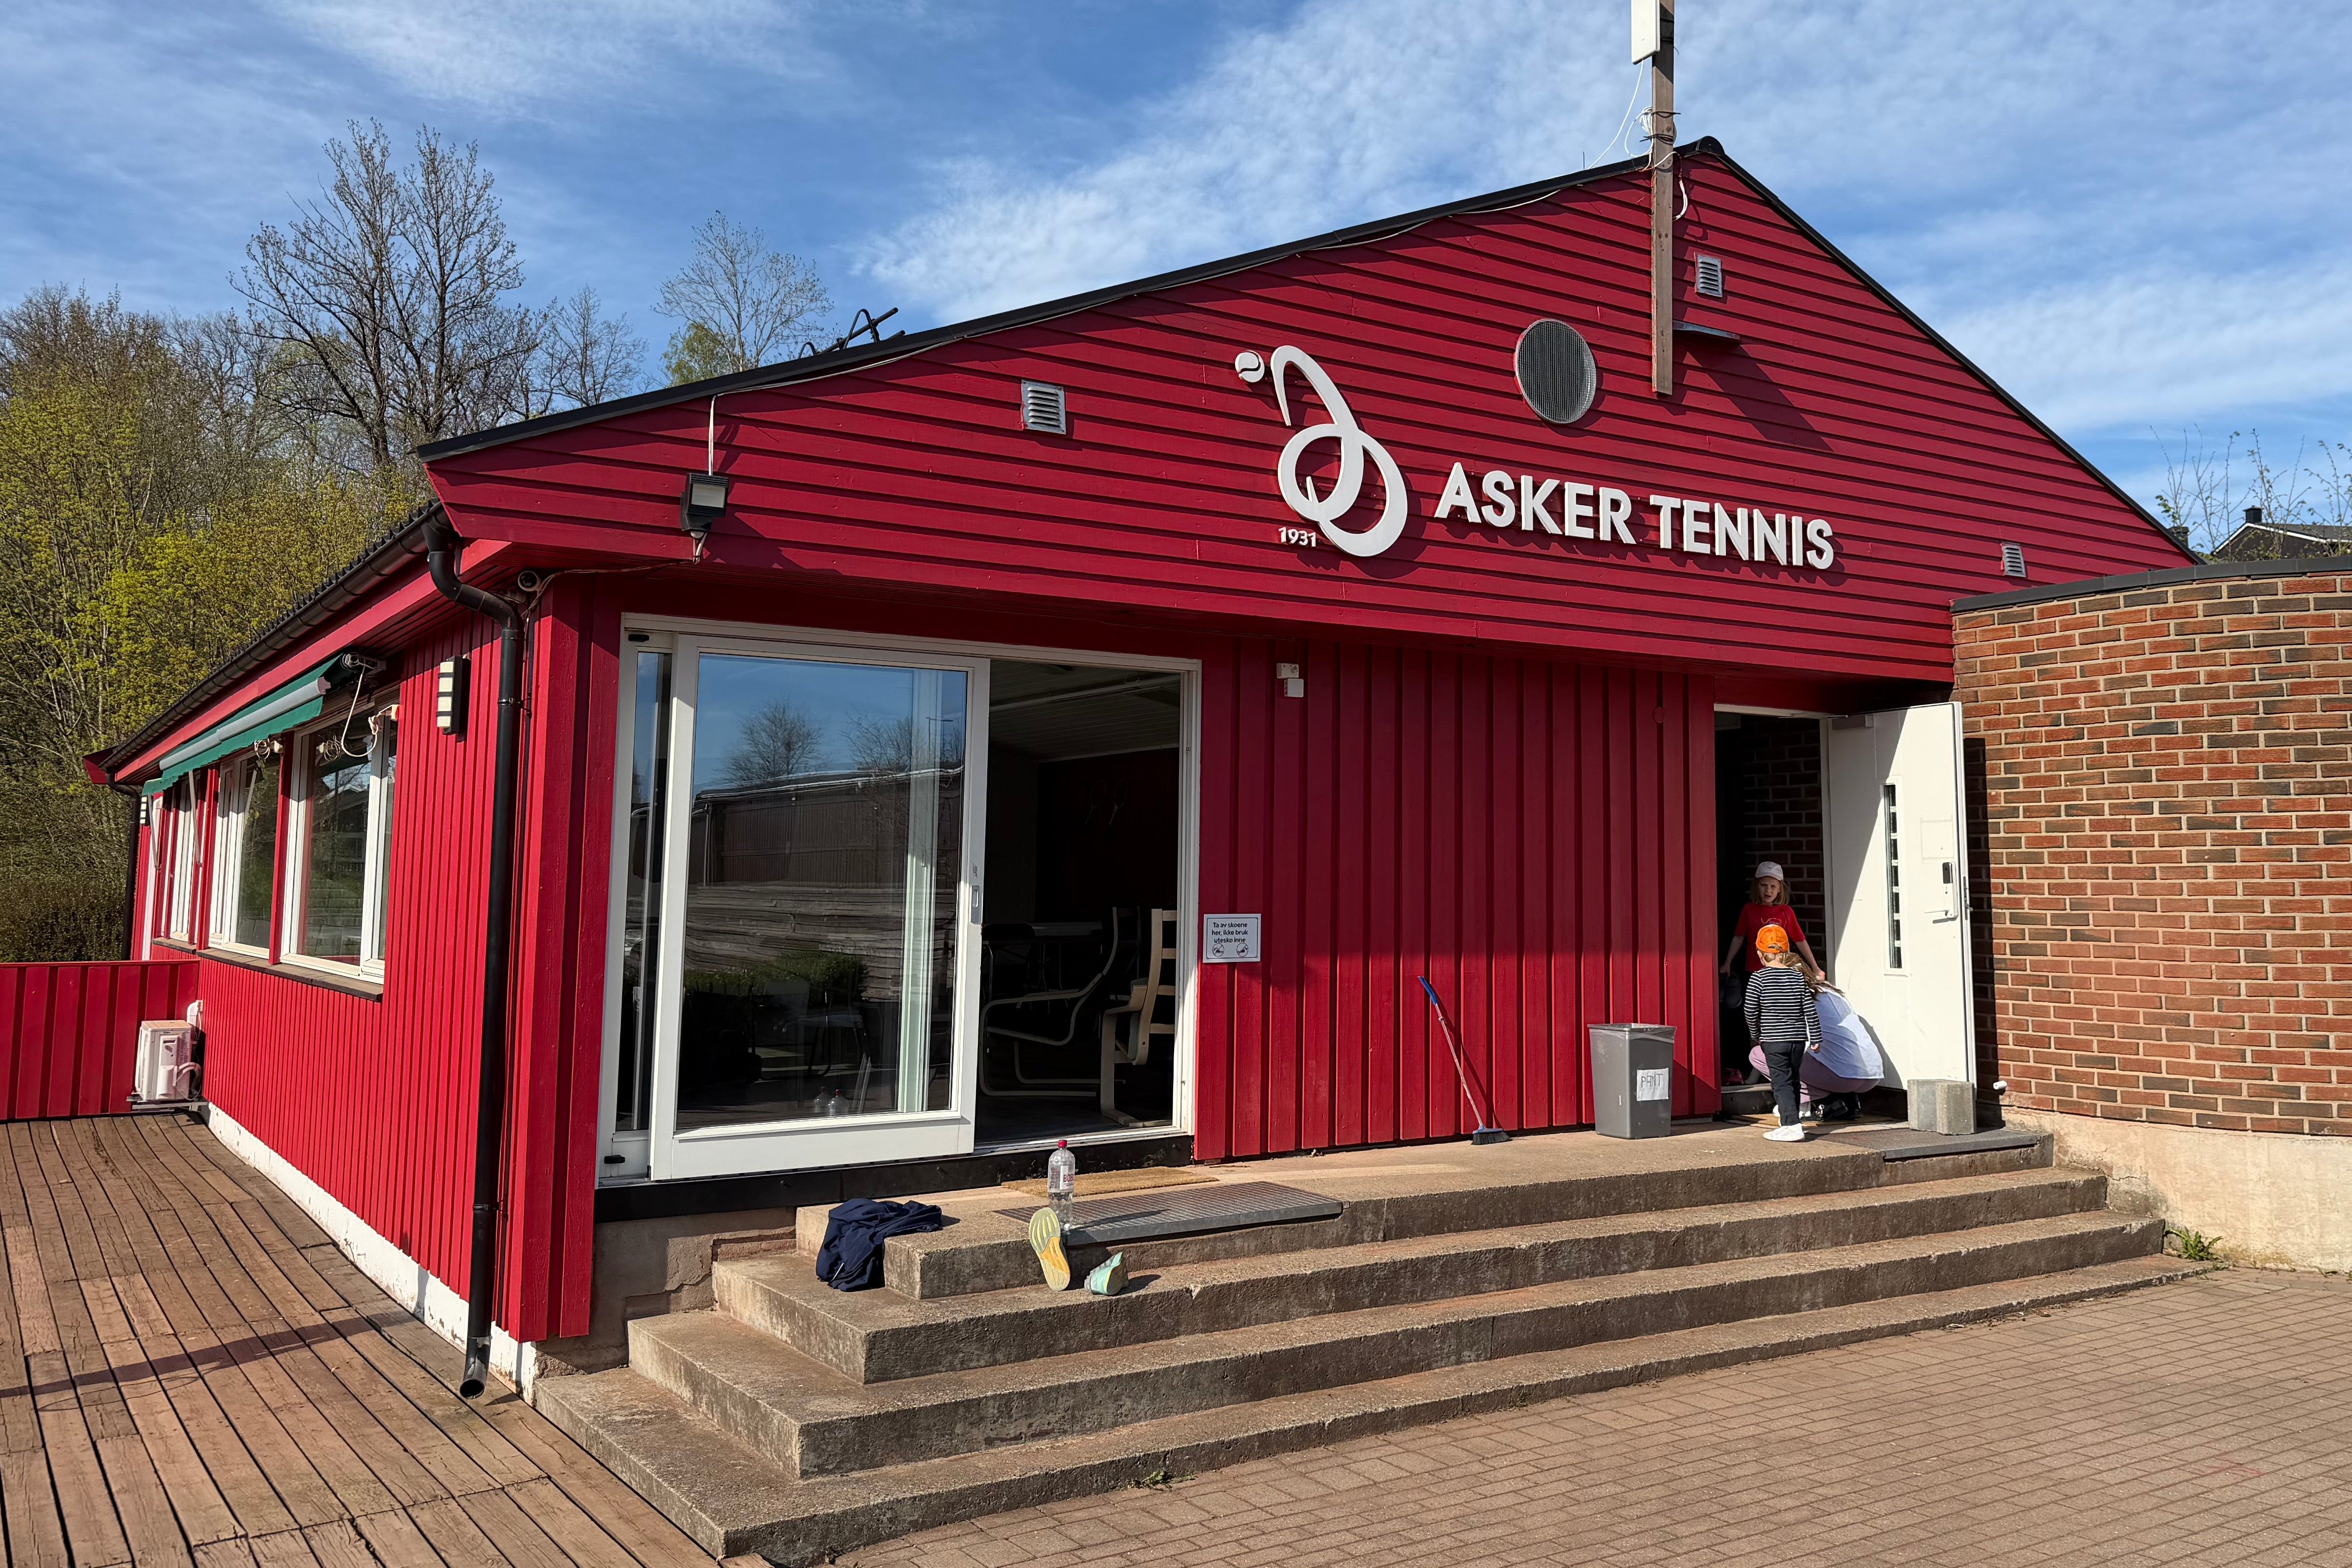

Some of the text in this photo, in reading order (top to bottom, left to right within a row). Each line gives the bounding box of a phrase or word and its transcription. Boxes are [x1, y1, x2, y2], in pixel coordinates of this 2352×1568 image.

[1434, 462, 1834, 570] ASKER TENNIS
[1278, 527, 1316, 547] 1931
[1641, 1073, 1663, 1088] PANT
